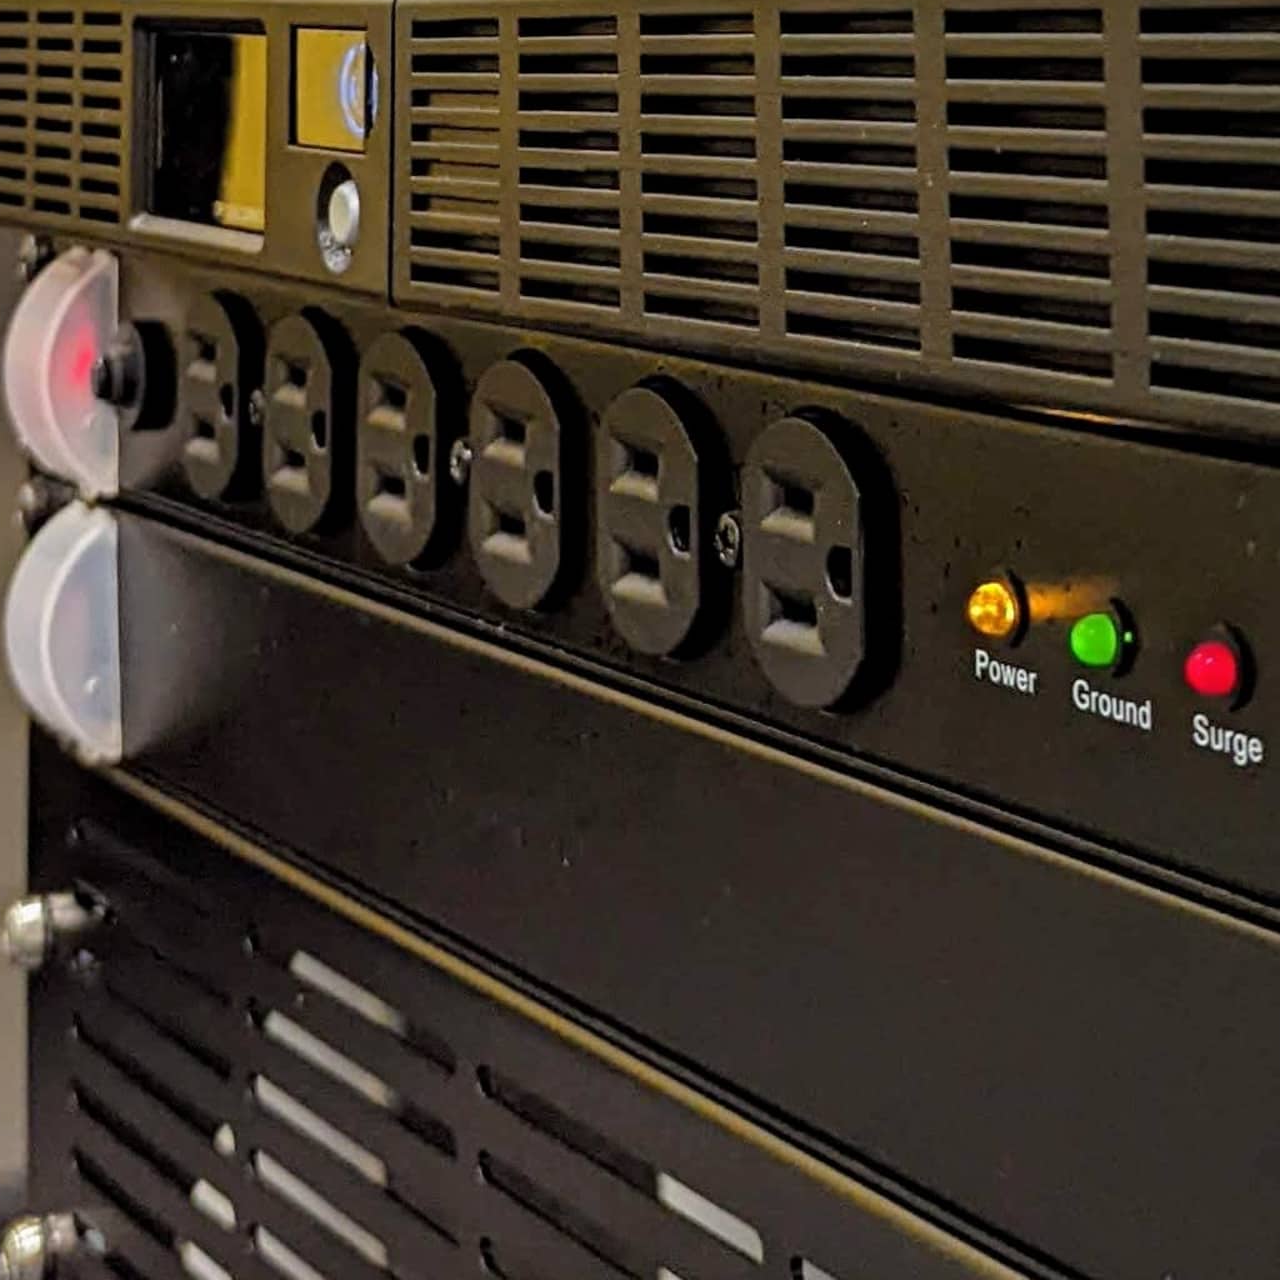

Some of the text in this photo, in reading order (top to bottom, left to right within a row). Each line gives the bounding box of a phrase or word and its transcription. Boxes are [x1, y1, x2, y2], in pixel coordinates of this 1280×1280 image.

[974, 649, 1038, 694] Power
[1071, 679, 1153, 731] Ground
[1192, 714, 1264, 766] Surge
